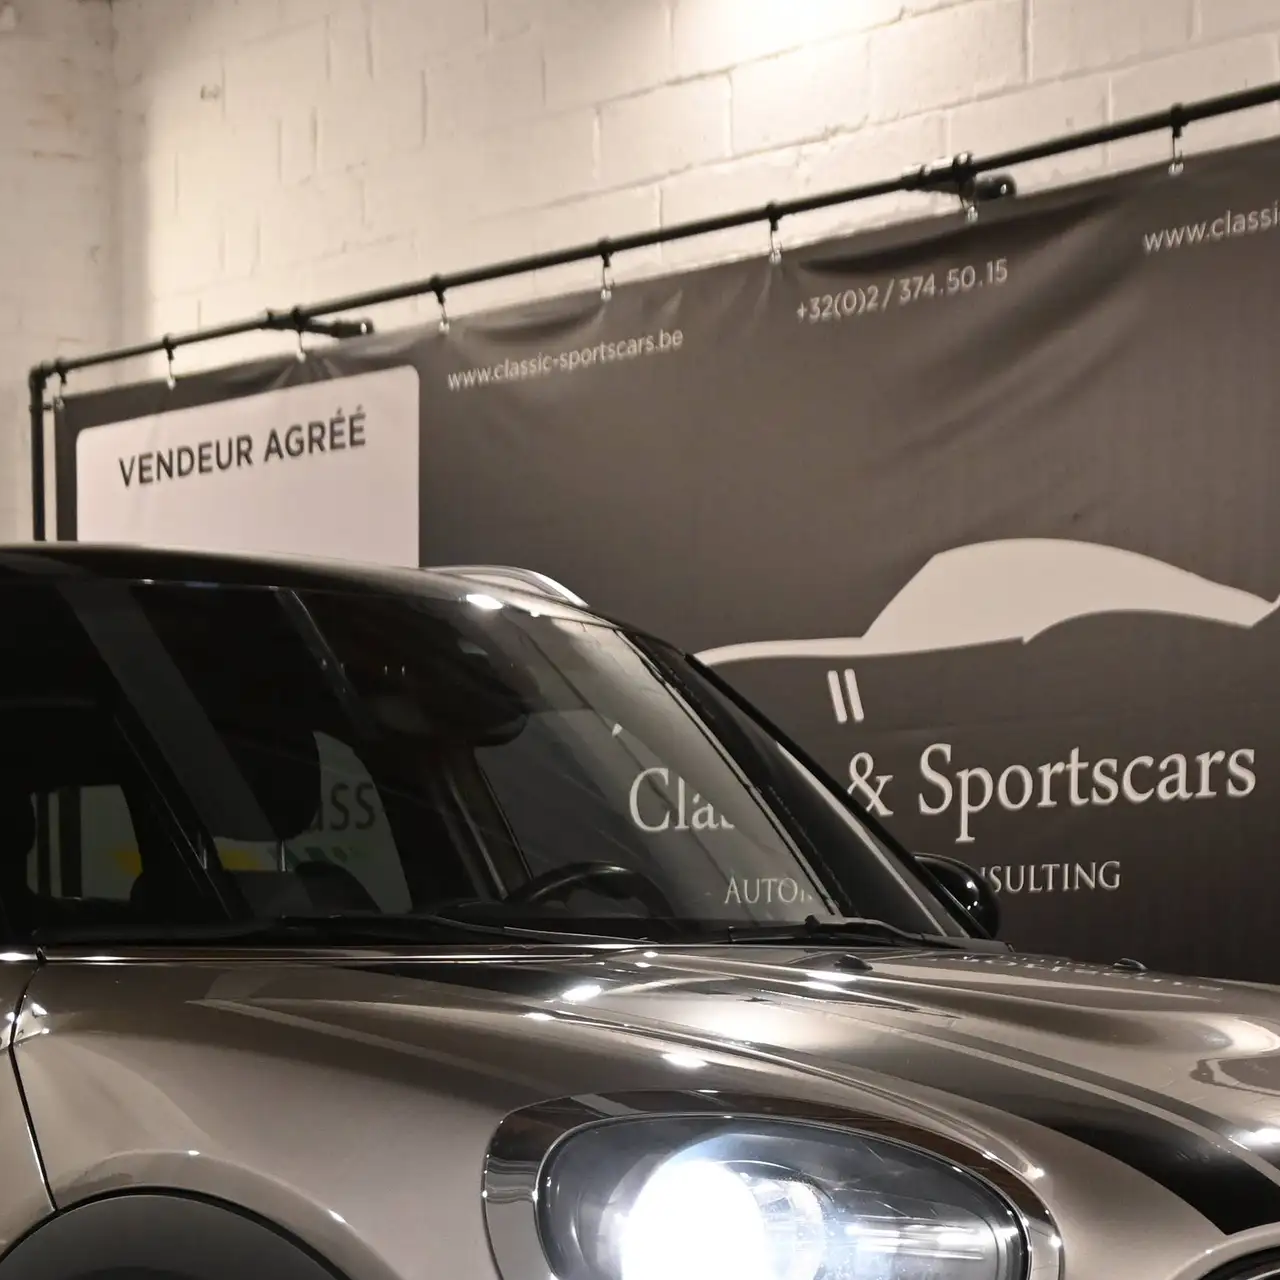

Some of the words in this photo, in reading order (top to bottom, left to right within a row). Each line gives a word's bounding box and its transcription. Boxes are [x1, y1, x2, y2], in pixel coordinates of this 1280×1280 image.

[447, 328, 684, 391] www.classic-sportscars.be
[118, 435, 254, 487] VENDEUR
[264, 405, 367, 462] AGRÉÉ
[847, 751, 894, 817] &
[918, 742, 1257, 843] Sportscars
